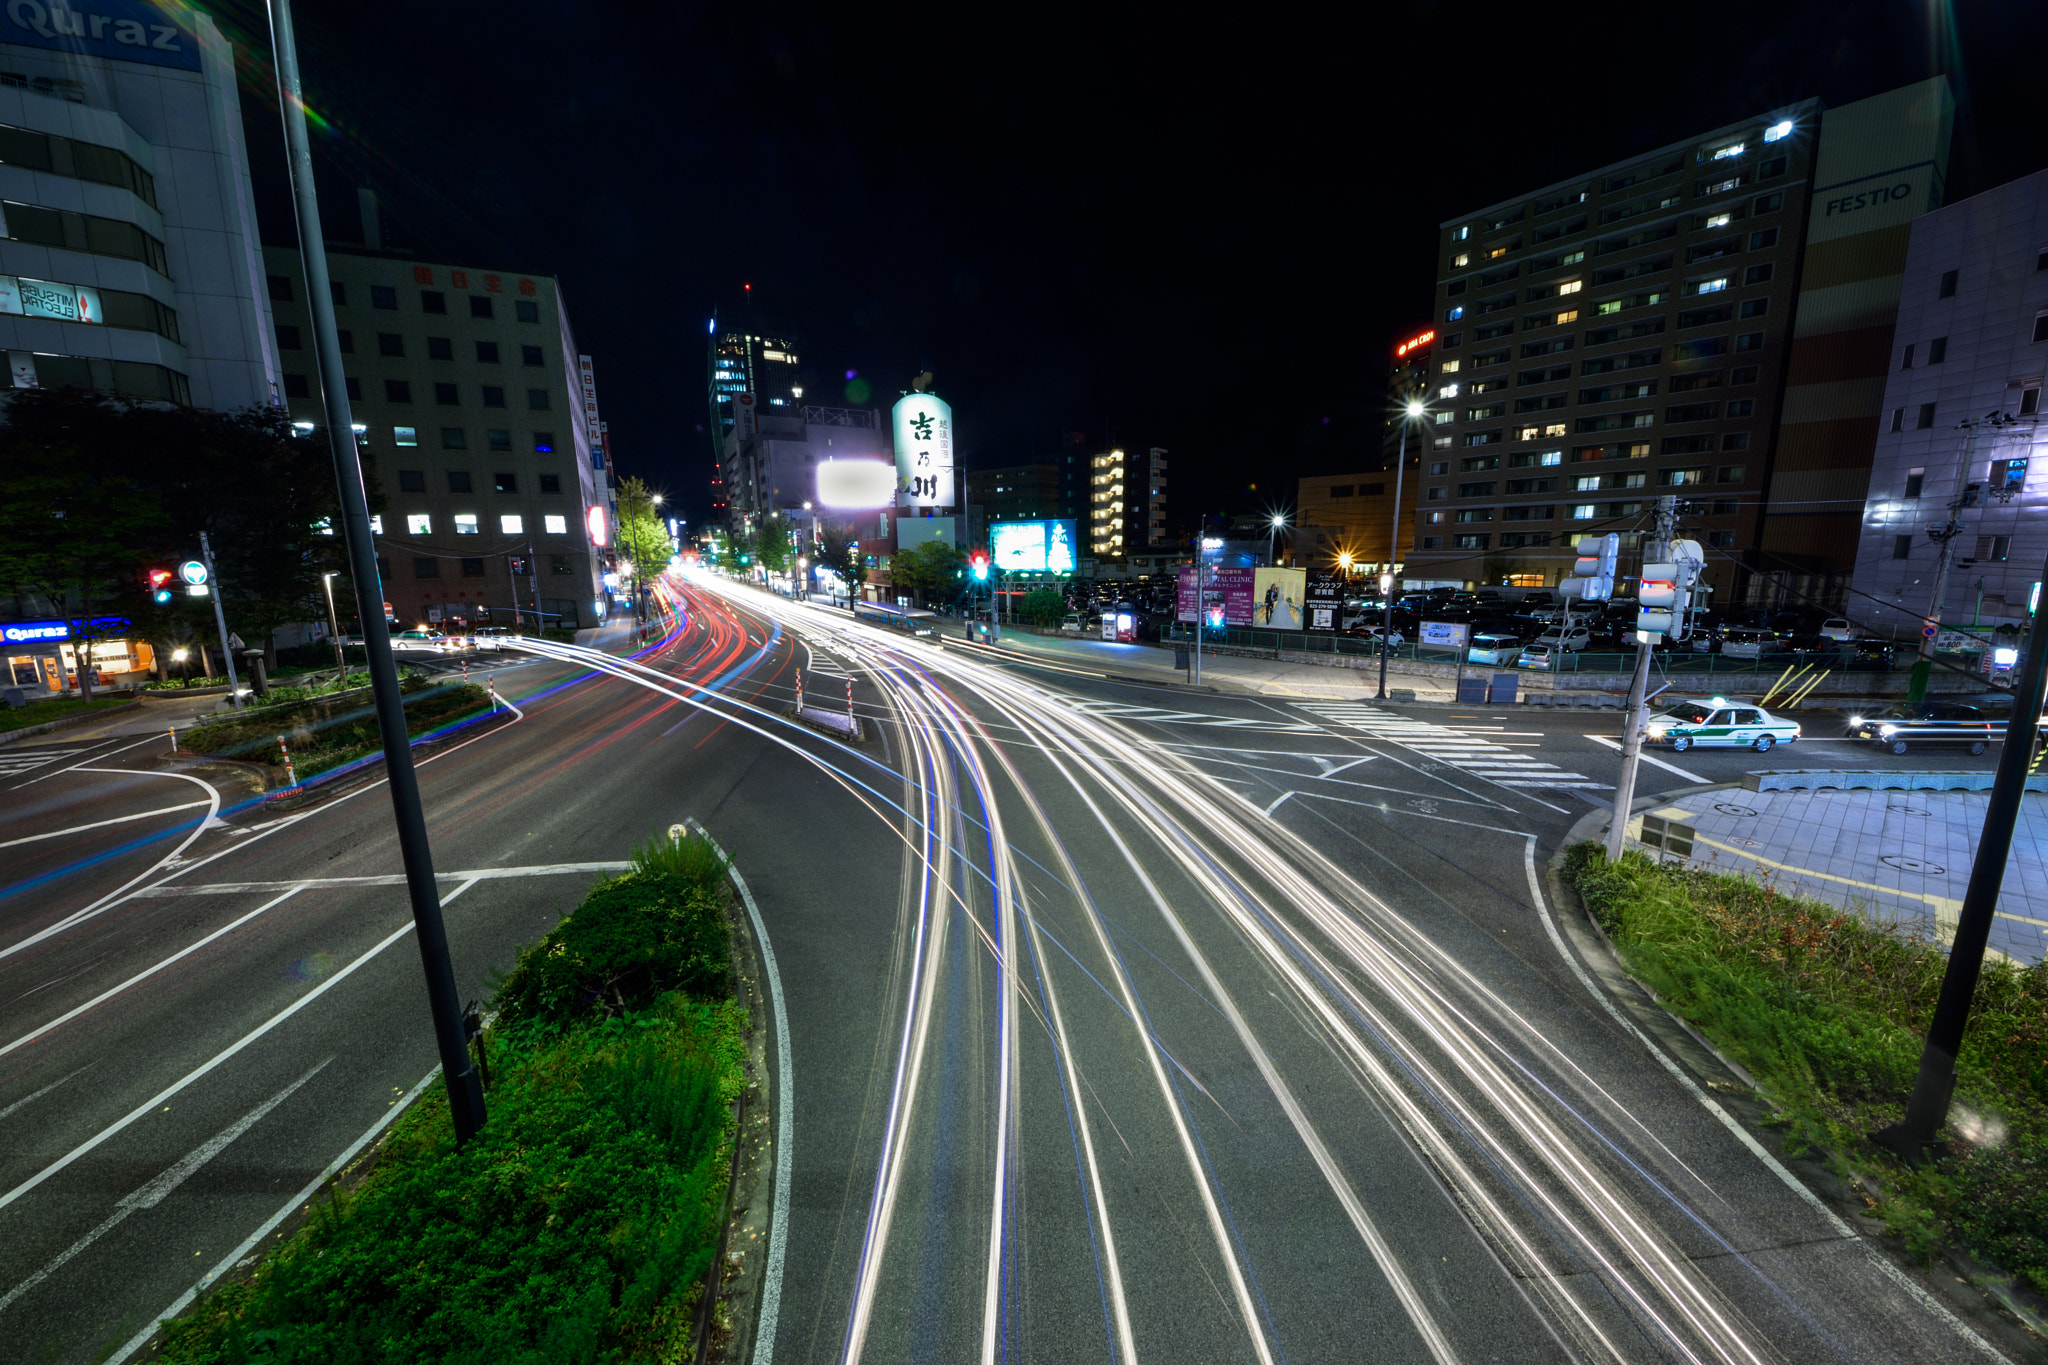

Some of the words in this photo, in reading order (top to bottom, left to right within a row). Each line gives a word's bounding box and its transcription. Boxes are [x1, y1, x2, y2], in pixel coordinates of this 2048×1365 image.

[6, 0, 182, 53] Quraz
[1826, 183, 1912, 216] FESTIO
[581, 360, 600, 440] 朝日生命ビル
[909, 411, 938, 499] 吉乃川
[6, 627, 68, 641] Quraz
